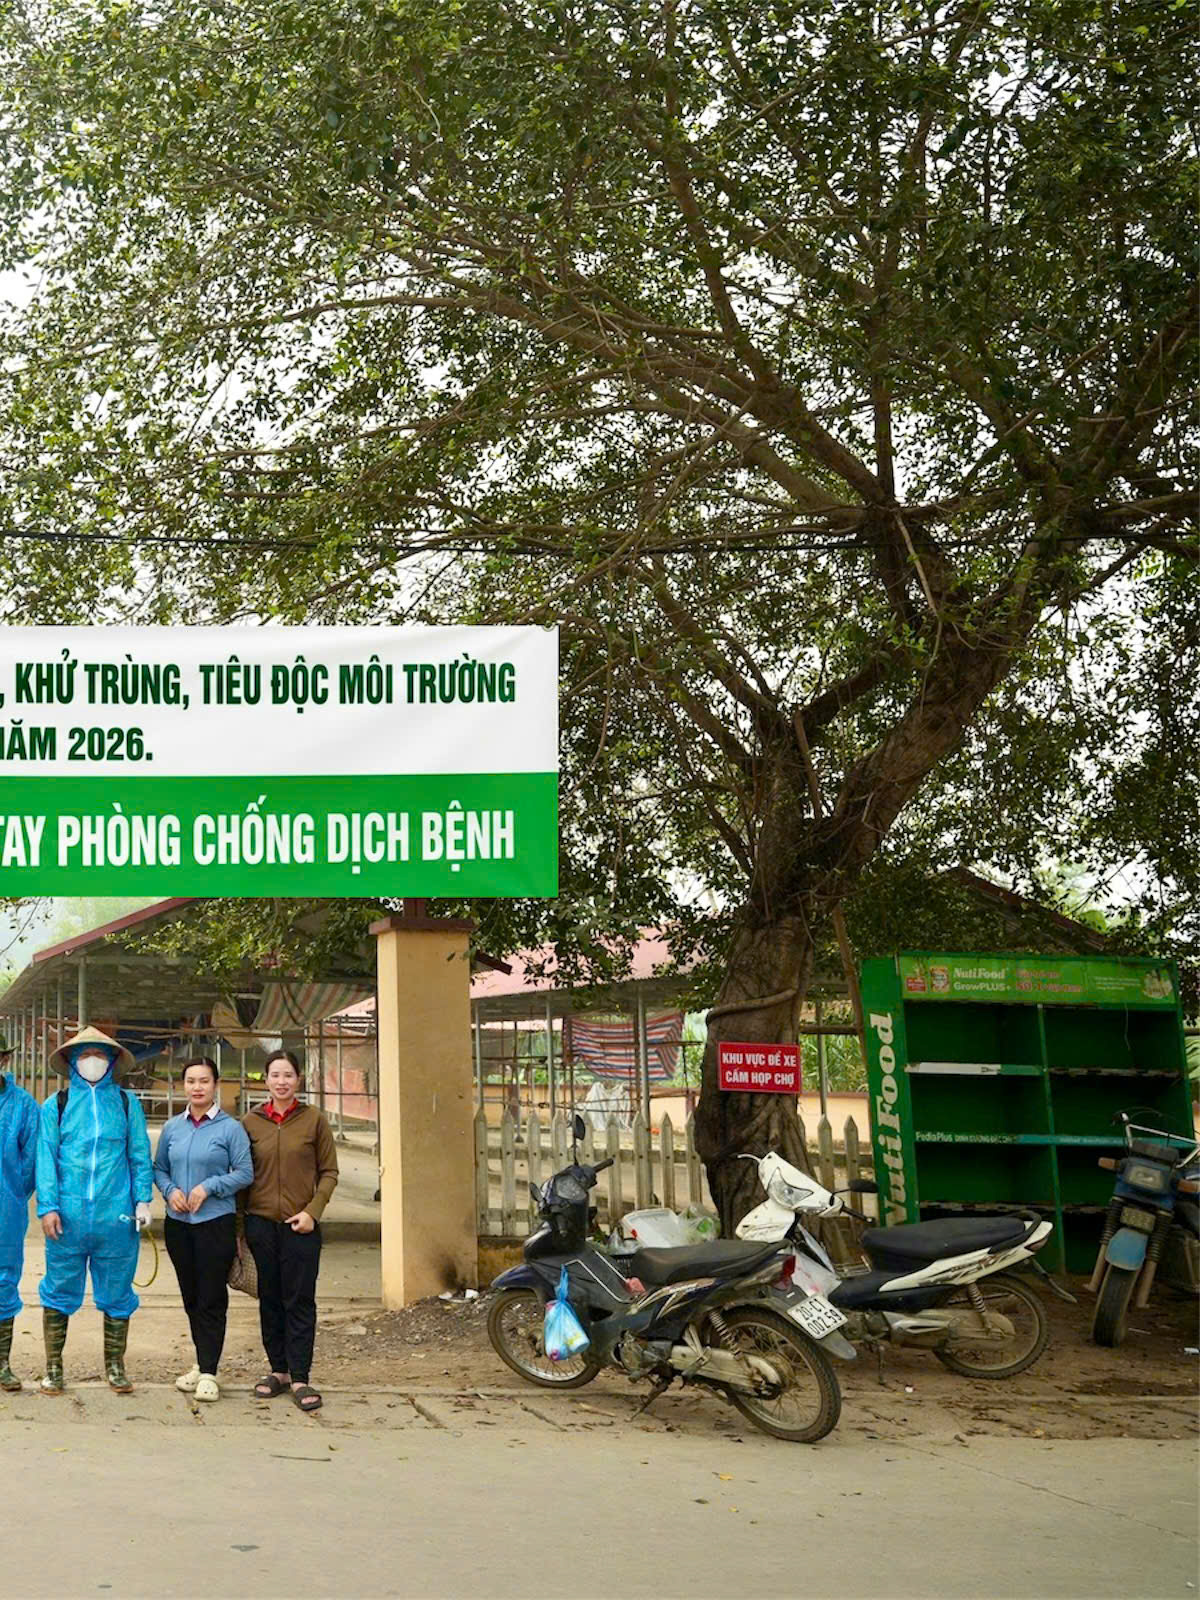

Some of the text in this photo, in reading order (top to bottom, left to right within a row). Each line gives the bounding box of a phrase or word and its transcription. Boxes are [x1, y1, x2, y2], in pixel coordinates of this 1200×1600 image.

[15, 648, 77, 704] KHỬ
[84, 654, 190, 710] TRÙNG,
[199, 655, 262, 705] TIÊU
[271, 655, 329, 713] ĐỘC
[338, 655, 393, 705] MÔI
[403, 653, 516, 704] TRƯỜNG
[68, 727, 153, 761] 2026.
[58, 803, 181, 867] PHÒNG
[193, 795, 315, 866] CHỐNG
[328, 812, 409, 875] DỊCH
[421, 800, 515, 872] BỆNH
[953, 967, 1006, 980] NutiFood
[953, 981, 1011, 992] GrowPLUS+
[722, 1050, 797, 1068] KHU VỰC ĐỂ XE
[725, 1067, 795, 1087] CẤM HỌP CHỢ
